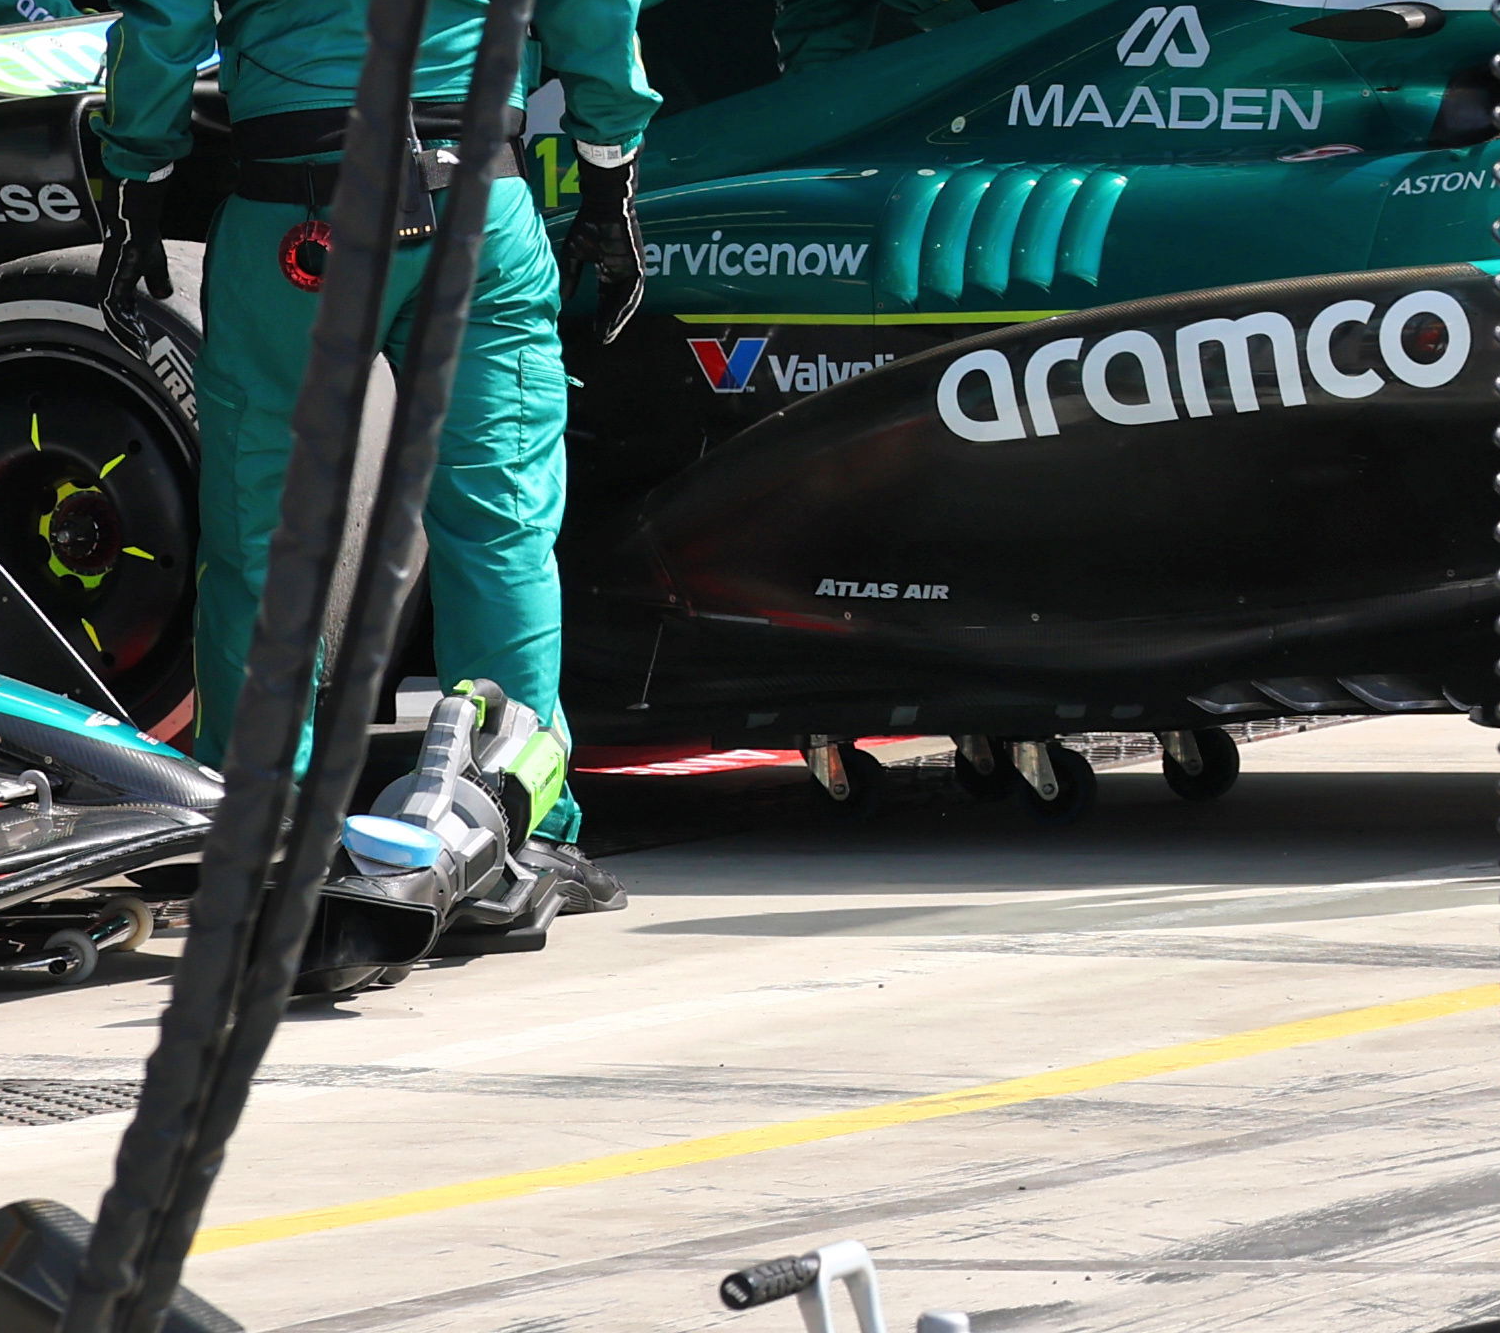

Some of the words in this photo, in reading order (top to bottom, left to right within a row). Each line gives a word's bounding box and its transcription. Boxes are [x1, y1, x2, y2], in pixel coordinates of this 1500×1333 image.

[1007, 85, 1323, 131] MAADEN
[1392, 167, 1486, 196] ASTON
[643, 229, 870, 278] ervicenow
[935, 288, 1472, 444] aramco
[814, 578, 900, 600] ATLAS
[903, 582, 950, 601] AIR
